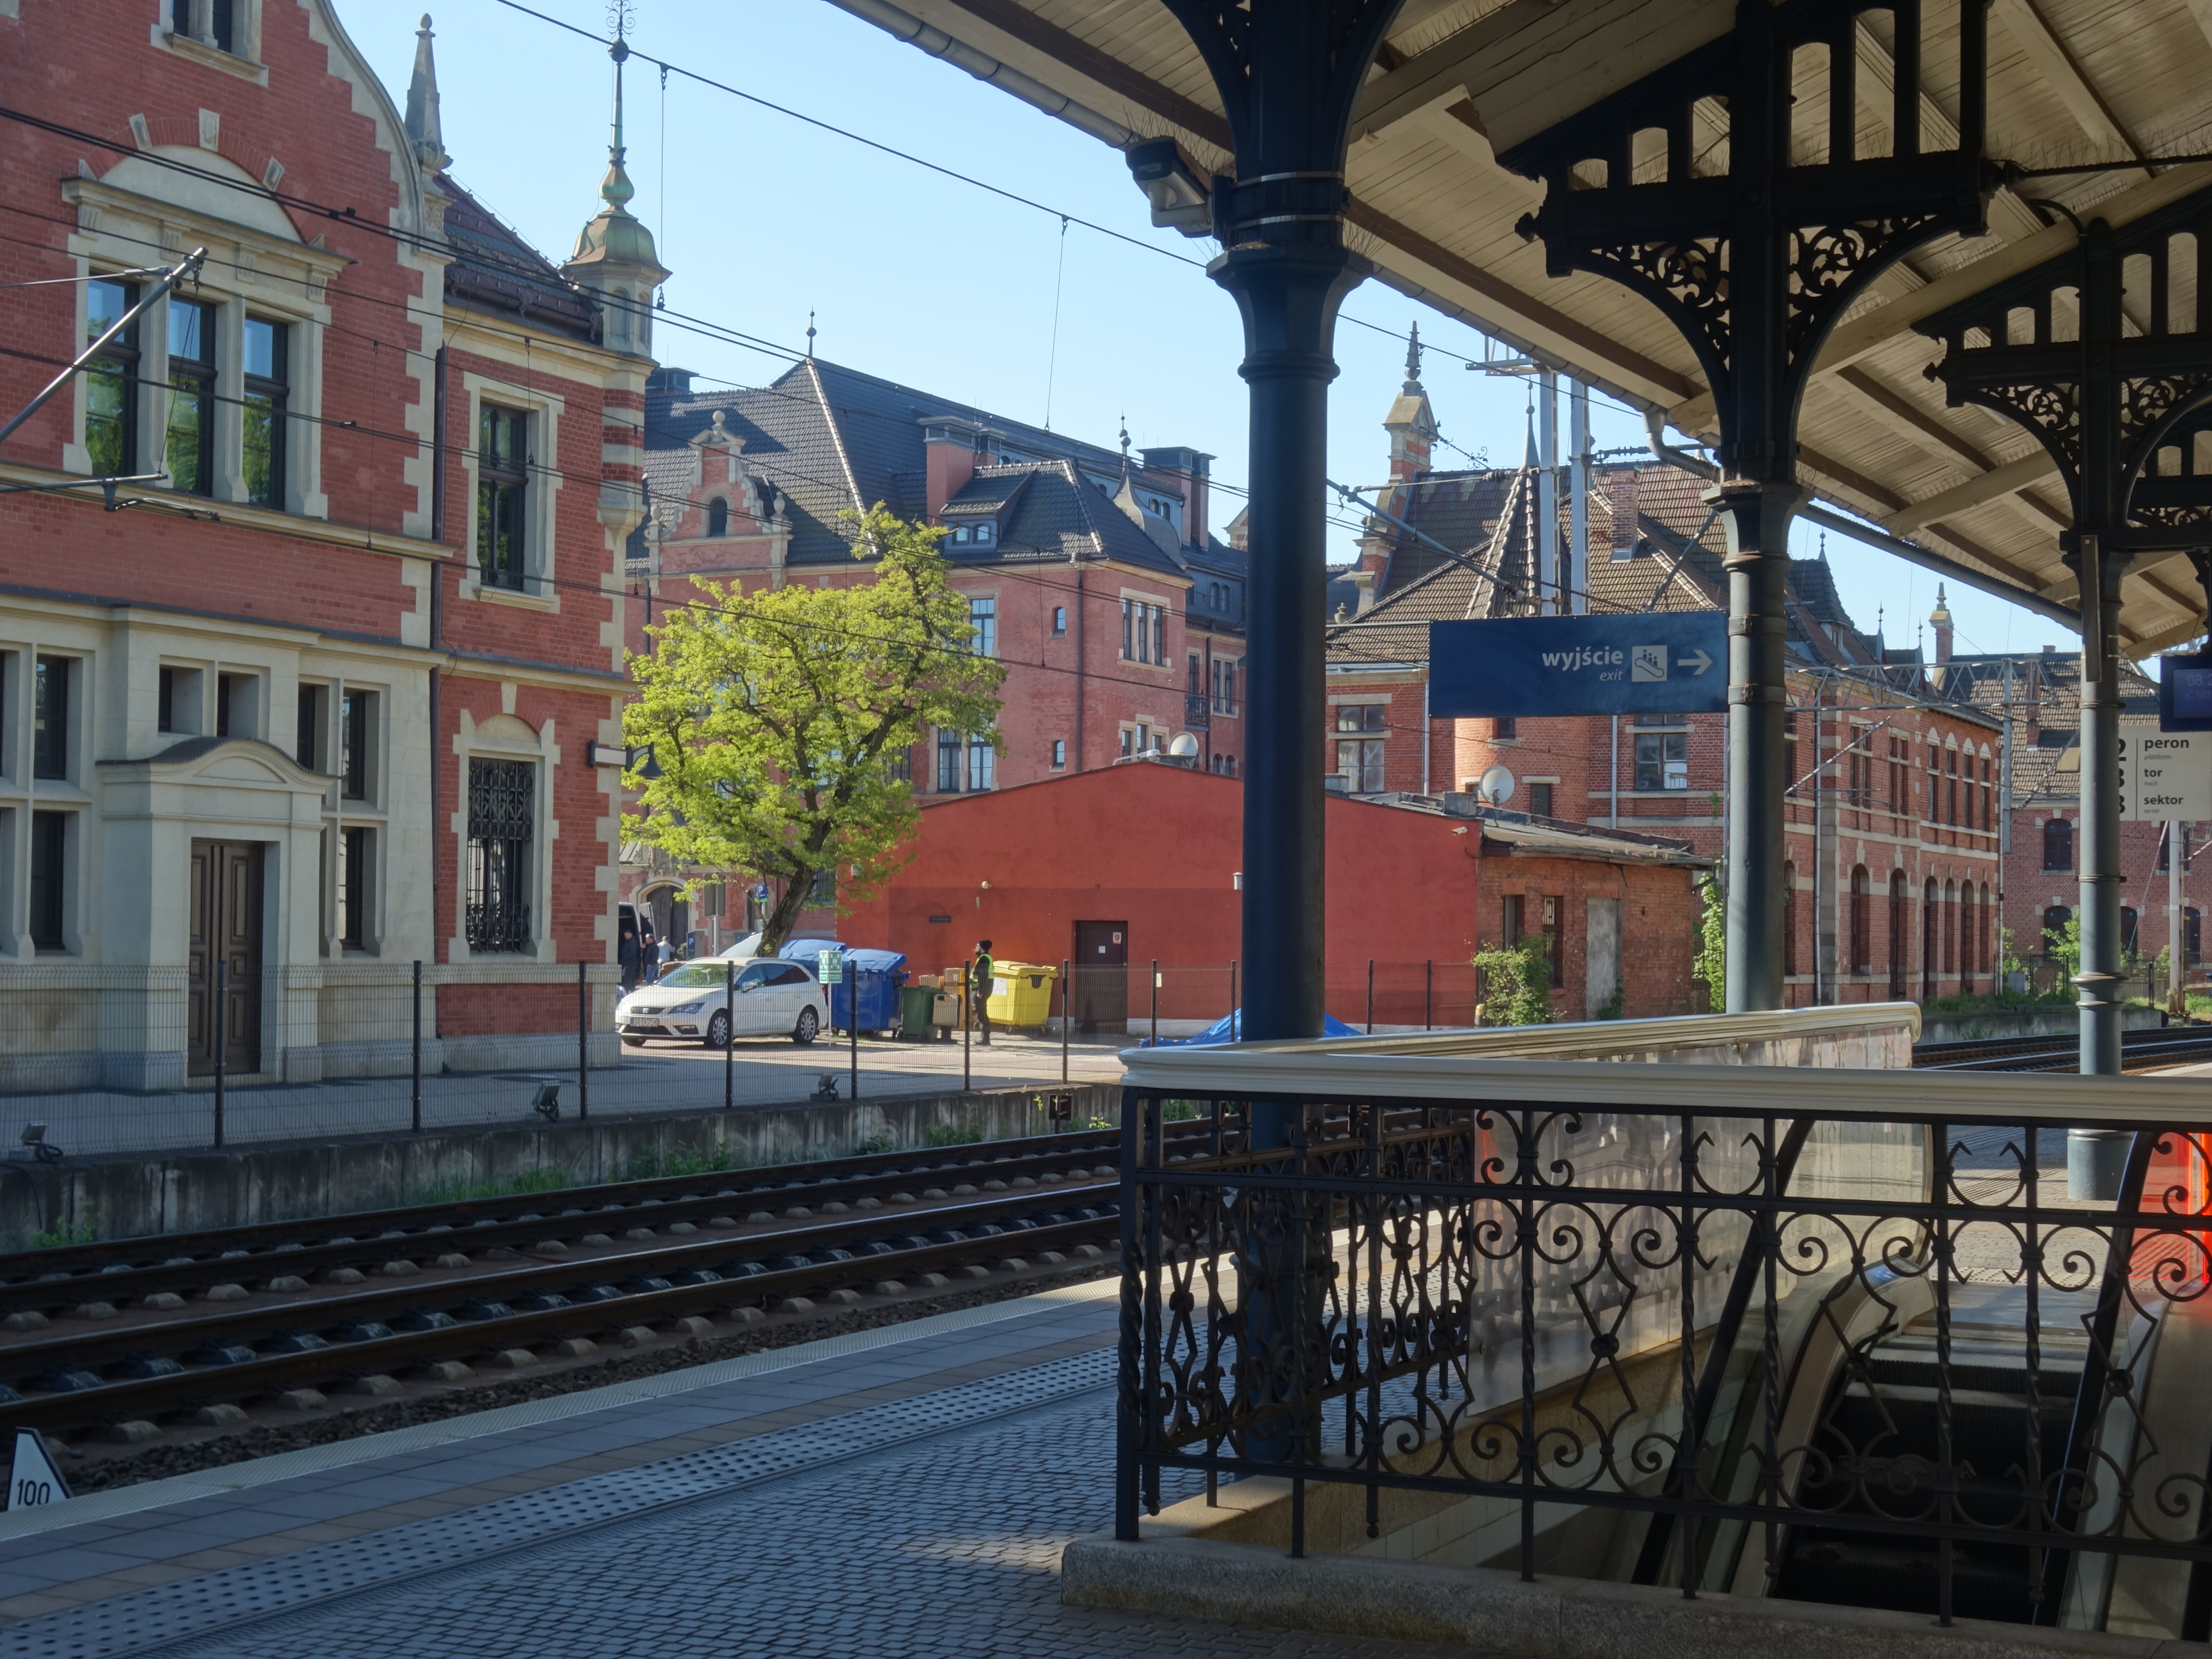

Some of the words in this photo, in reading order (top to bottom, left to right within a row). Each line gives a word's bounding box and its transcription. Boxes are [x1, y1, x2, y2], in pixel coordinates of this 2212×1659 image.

[1542, 646, 1624, 672] wyjście
[1600, 669, 1623, 681] exit
[2144, 739, 2189, 751] peron
[2144, 768, 2163, 777] tor
[2144, 794, 2183, 805] sektor
[17, 1478, 50, 1506] 100
